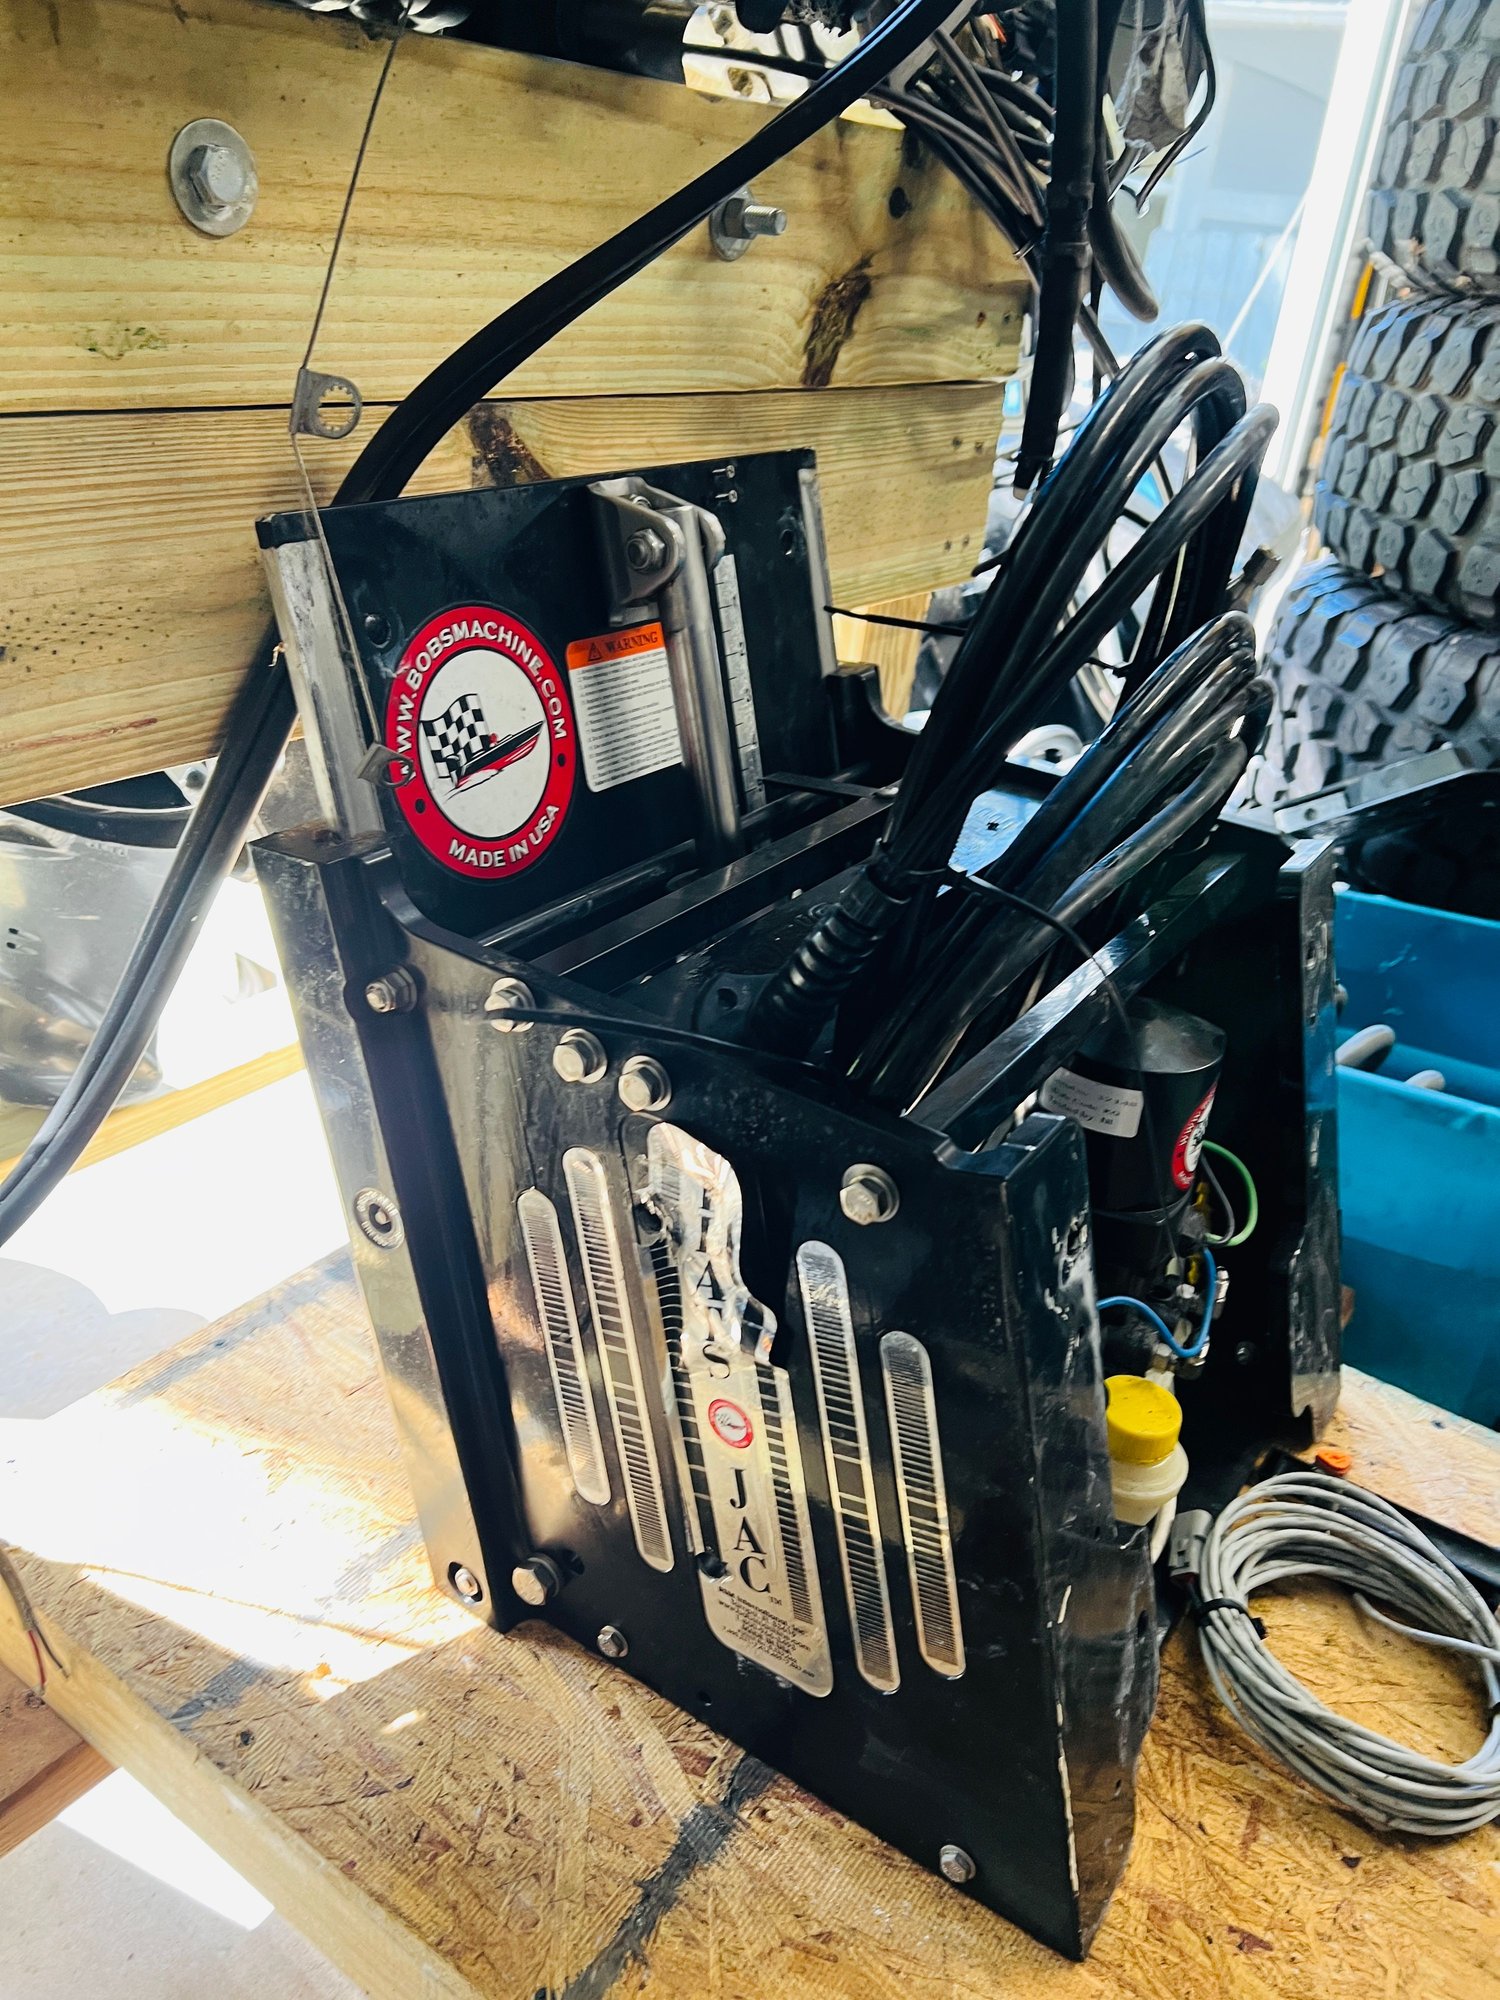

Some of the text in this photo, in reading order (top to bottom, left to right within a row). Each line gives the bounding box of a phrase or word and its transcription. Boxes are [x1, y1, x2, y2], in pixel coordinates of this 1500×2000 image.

[603, 630, 659, 655] WARNING
[448, 804, 560, 868] MADE IN USA
